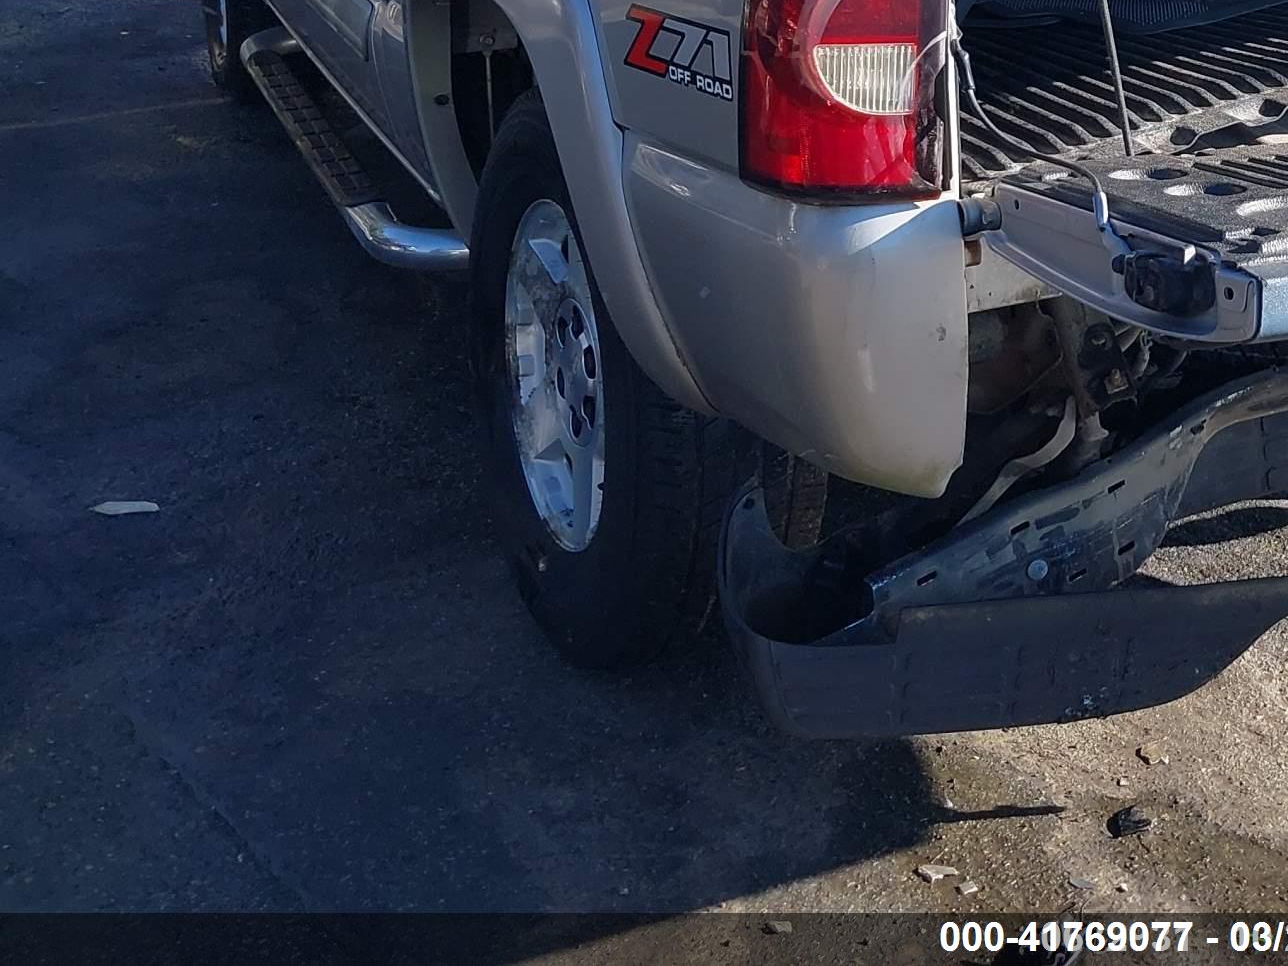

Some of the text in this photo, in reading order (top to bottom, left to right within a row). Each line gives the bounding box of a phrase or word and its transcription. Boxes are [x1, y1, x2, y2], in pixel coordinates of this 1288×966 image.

[625, 3, 731, 81] Z71
[668, 66, 732, 100] OFF ROAD
